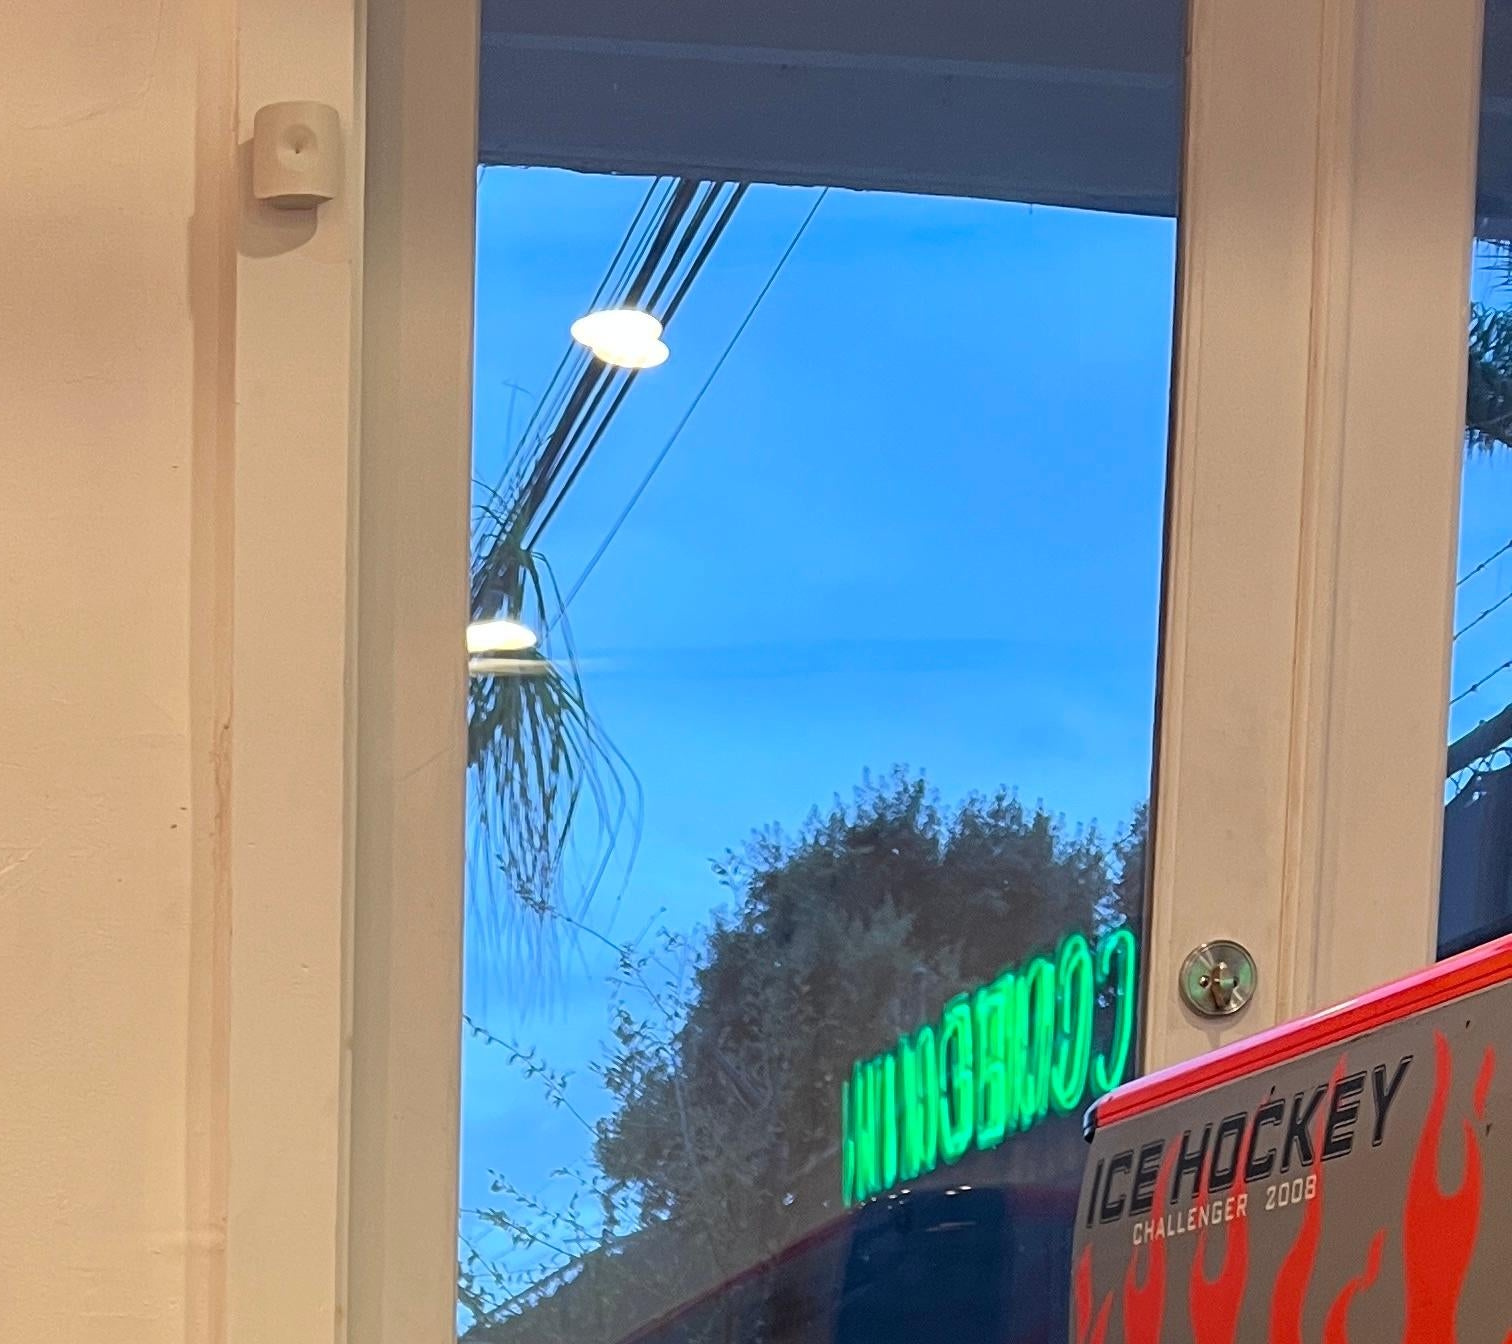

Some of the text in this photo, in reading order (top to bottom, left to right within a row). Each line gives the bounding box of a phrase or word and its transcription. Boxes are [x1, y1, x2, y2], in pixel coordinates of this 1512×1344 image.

[1086, 1054, 1413, 1228] ICE HOCKEY
[1133, 1174, 1317, 1245] CHALLENGER 2008
